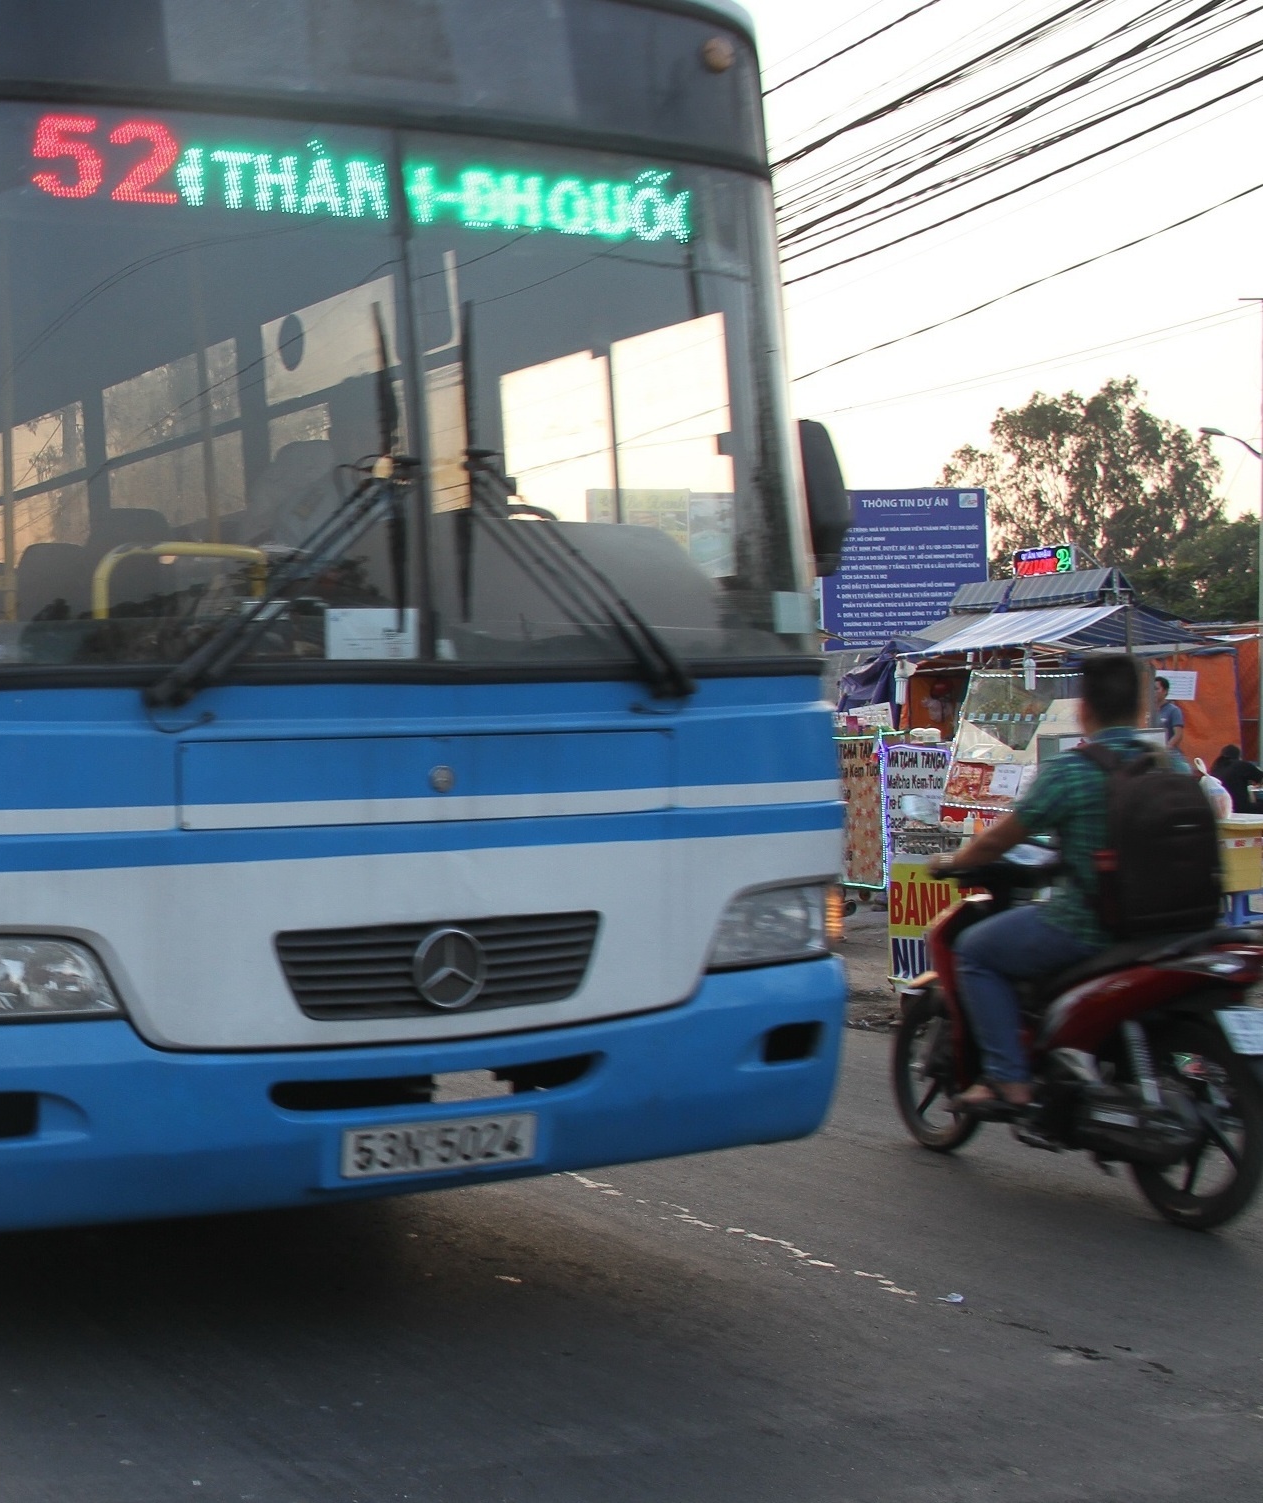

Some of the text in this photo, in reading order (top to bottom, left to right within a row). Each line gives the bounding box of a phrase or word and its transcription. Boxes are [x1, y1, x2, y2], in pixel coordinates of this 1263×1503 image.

[33, 116, 178, 205] 52
[862, 496, 948, 509] THÔNG TIN DỰ ÁN
[887, 752, 946, 769] MATCHA TANGO
[887, 774, 910, 789] Matcha
